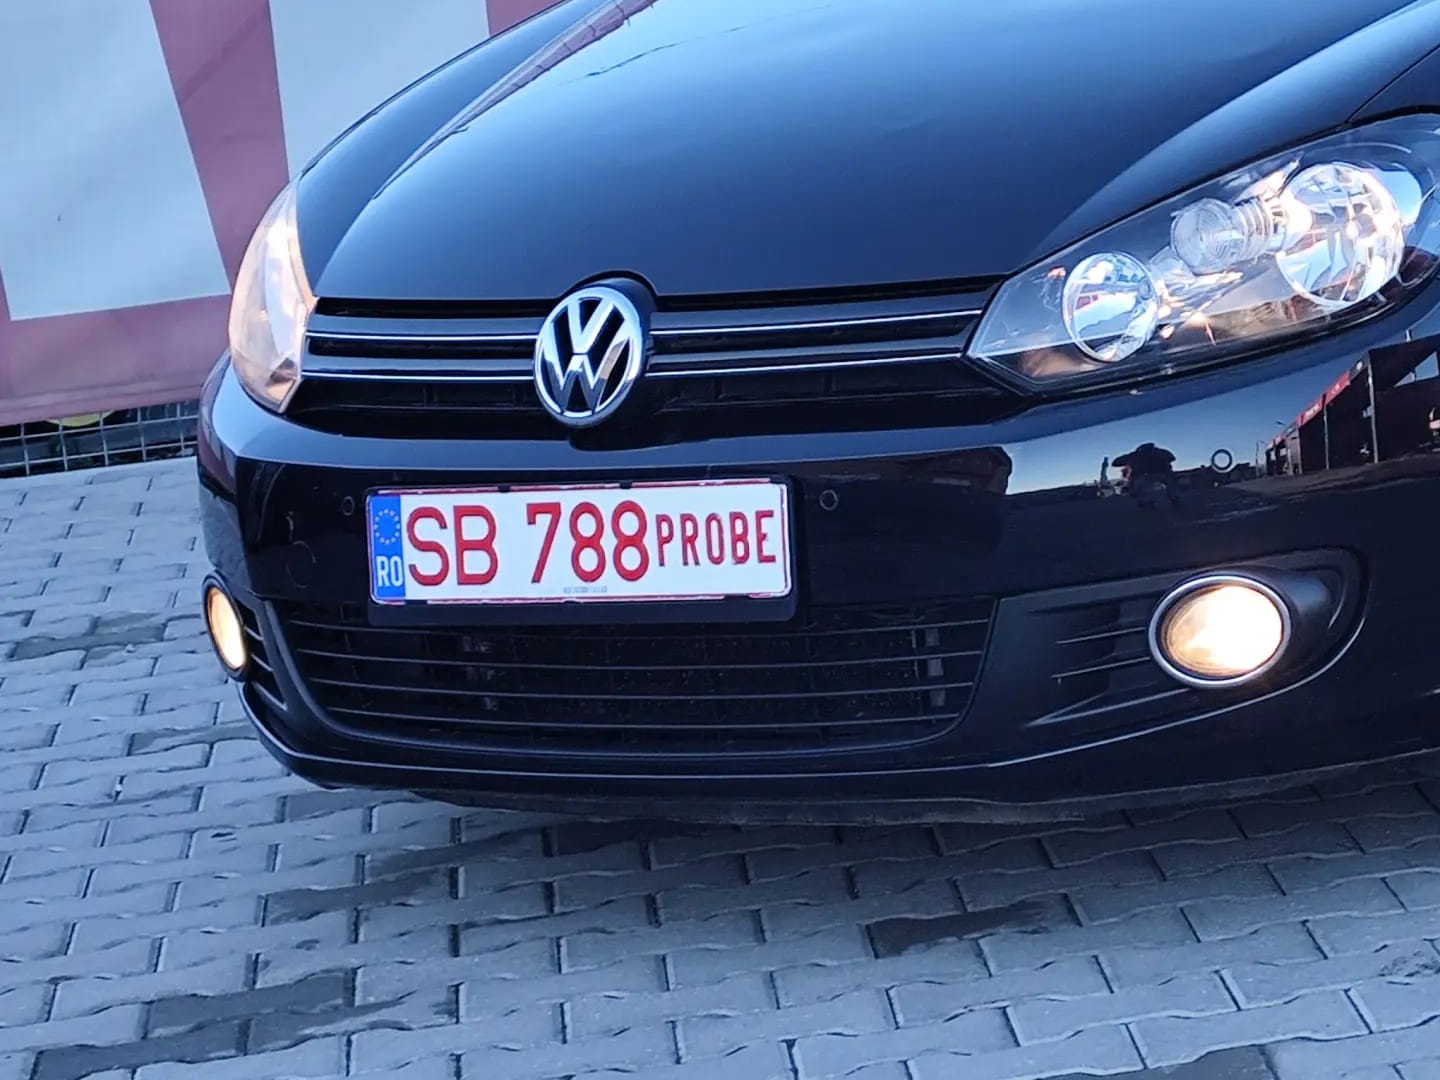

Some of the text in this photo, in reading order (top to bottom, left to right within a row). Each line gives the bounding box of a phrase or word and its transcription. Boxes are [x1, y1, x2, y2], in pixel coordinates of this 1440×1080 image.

[535, 286, 643, 425] VW
[376, 555, 404, 587] RO
[407, 500, 777, 586] SB 788 PROBE
